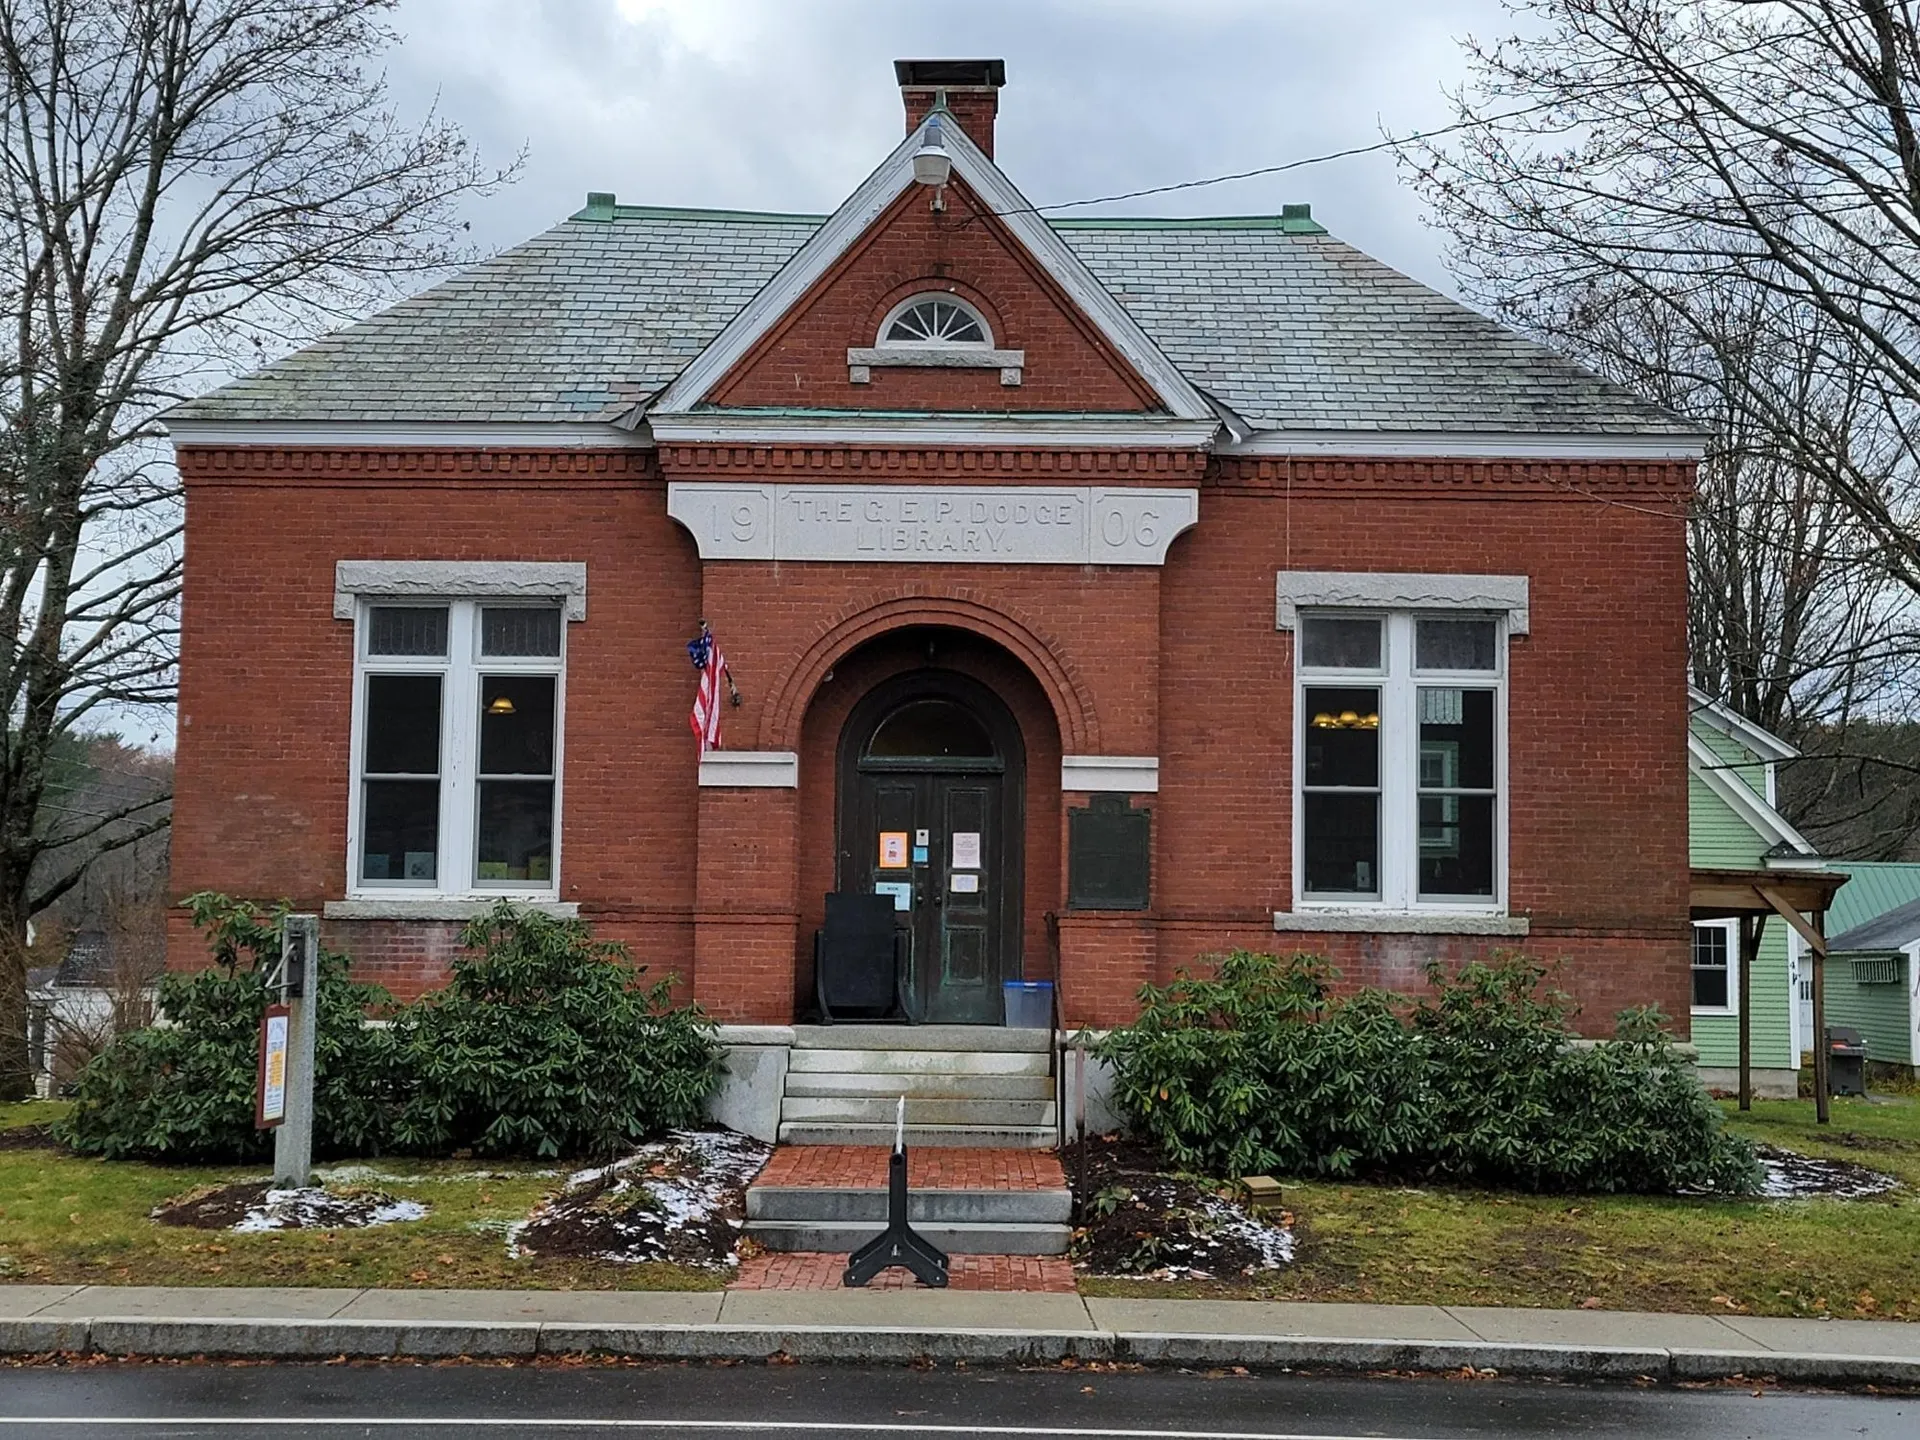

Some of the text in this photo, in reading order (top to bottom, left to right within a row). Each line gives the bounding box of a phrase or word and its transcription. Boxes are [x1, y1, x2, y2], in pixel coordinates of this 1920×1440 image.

[711, 502, 757, 543] 19
[791, 499, 853, 522] THE
[970, 502, 1072, 525] DODGE
[1101, 509, 1161, 548] 06
